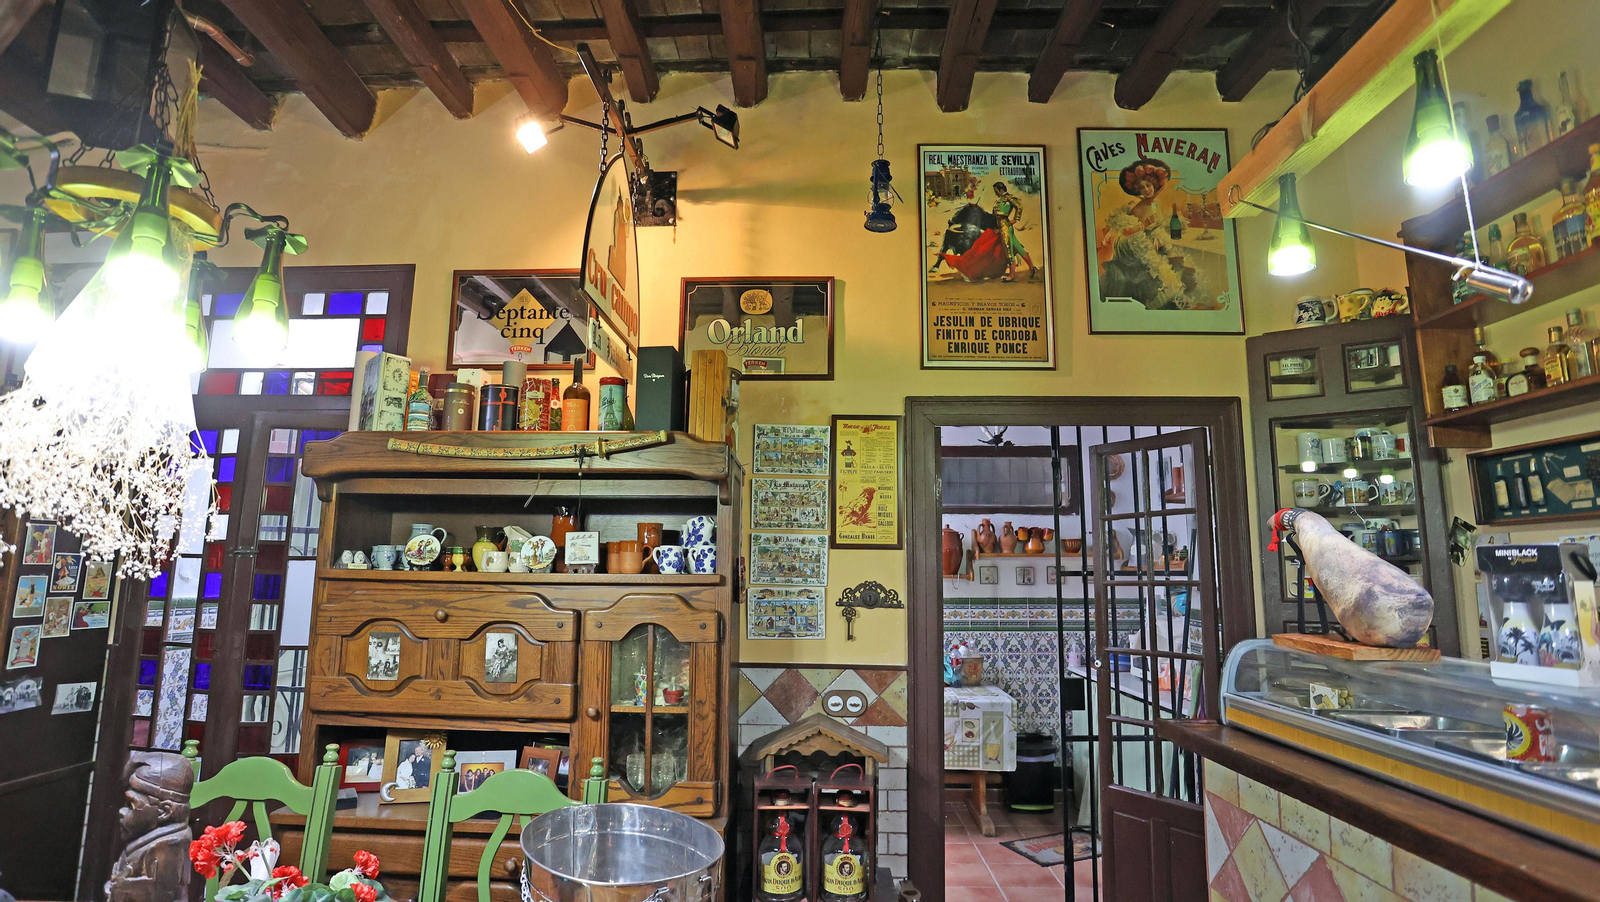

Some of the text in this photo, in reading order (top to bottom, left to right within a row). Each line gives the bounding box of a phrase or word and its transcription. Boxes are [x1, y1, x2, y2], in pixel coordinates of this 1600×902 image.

[929, 154, 1034, 166] REAL MAESTRANZA DE SEVILLA
[1086, 133, 1221, 173] CAVES NAVERAN
[477, 294, 570, 328] Septante
[612, 284, 638, 338] campo
[500, 322, 546, 344] cinq
[707, 318, 805, 344] Orland
[933, 316, 1040, 329] JESULIN DE UBRIQUE
[726, 333, 786, 356] Blonde
[936, 329, 1038, 341] FINITO DE CORDOBA
[948, 342, 1028, 354] ENRIQUE PONCE
